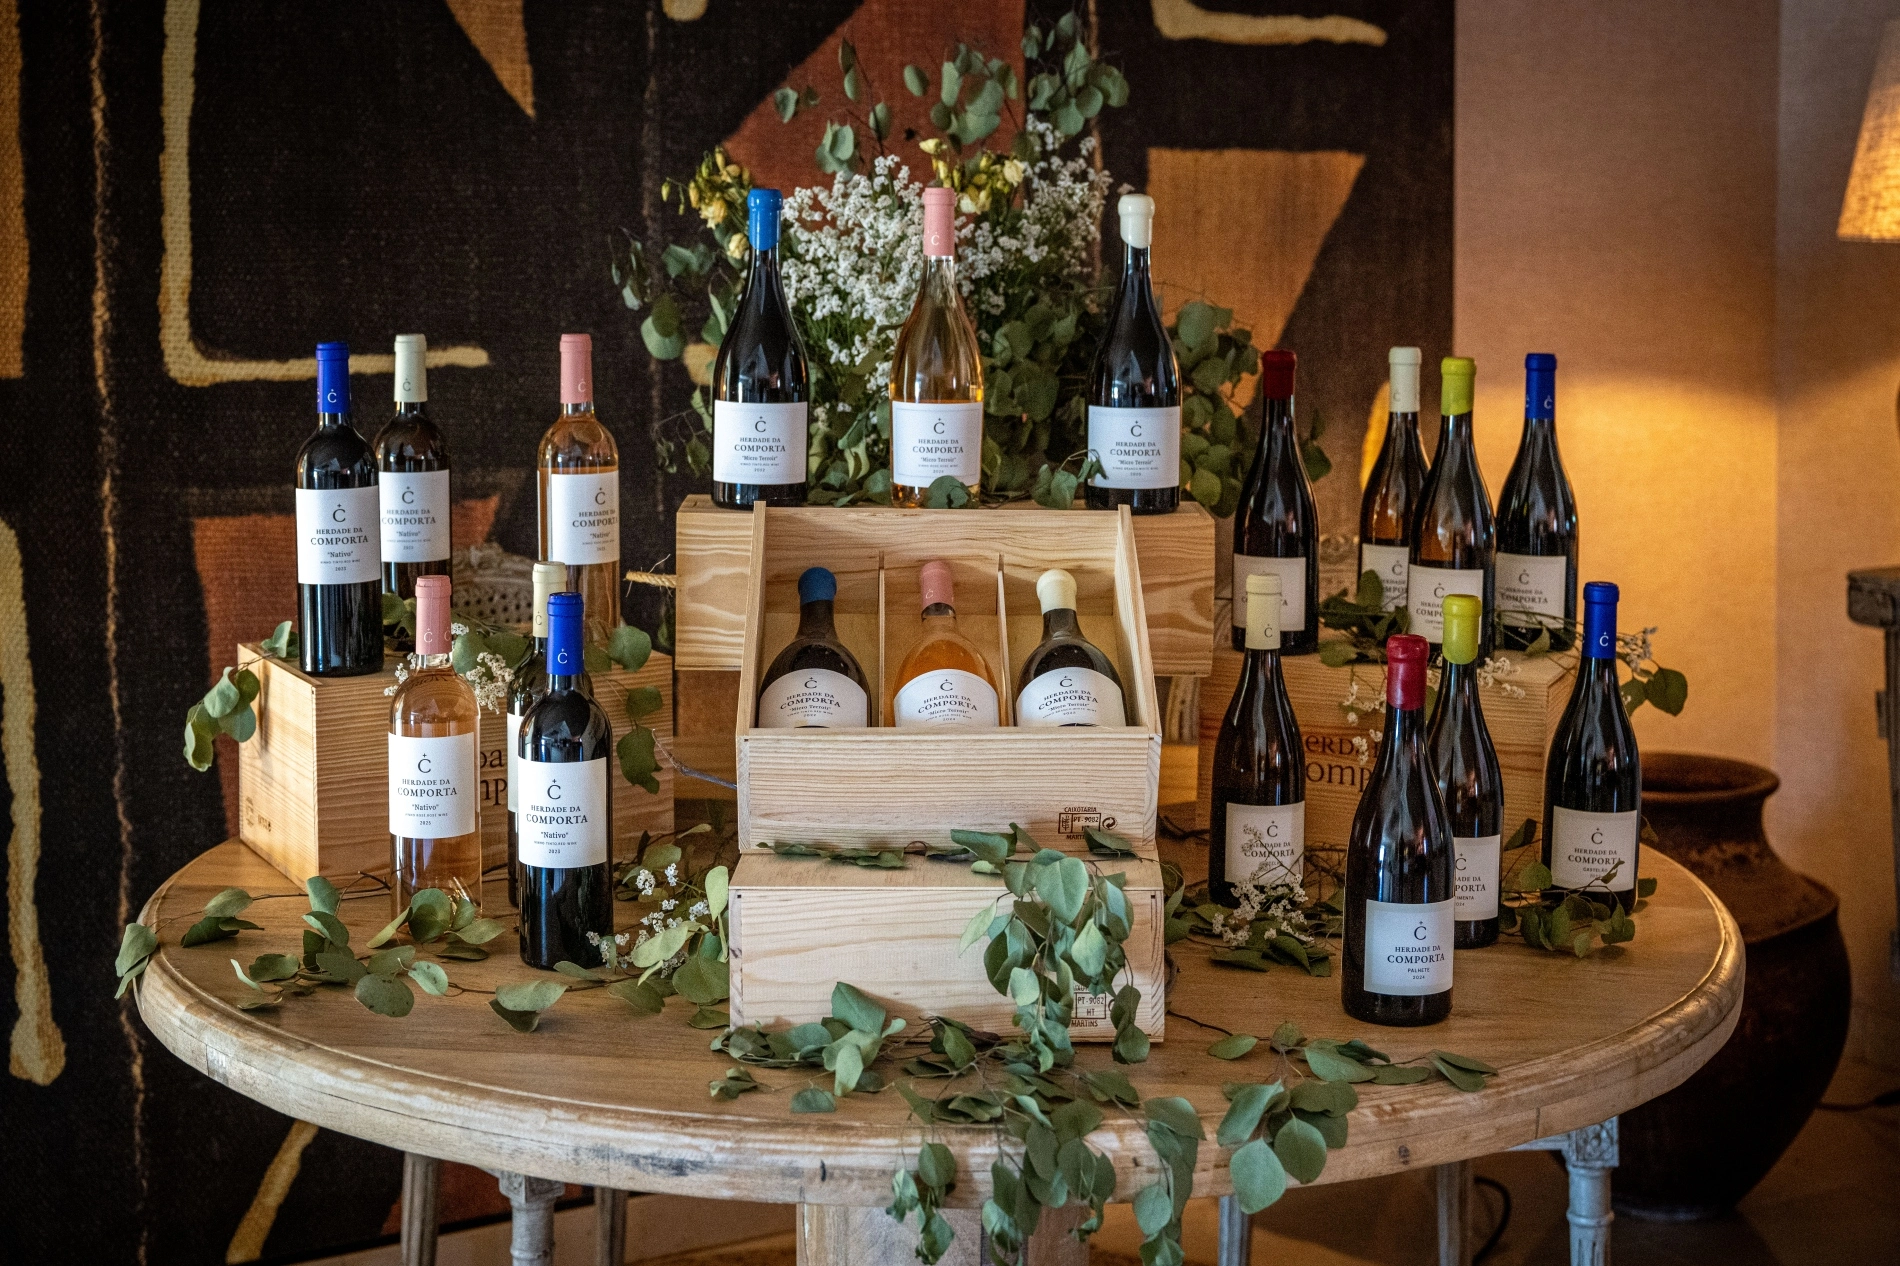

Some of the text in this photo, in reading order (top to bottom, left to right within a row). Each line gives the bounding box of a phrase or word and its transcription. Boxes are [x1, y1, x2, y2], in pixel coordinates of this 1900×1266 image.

[734, 444, 786, 452] COMPORTA
[1110, 449, 1161, 457] COMPORTA
[381, 516, 436, 525] COMPORTA
[316, 527, 352, 535] HERDADE
[310, 535, 369, 545] COMPORTA
[786, 692, 823, 700] HERDADE
[923, 694, 959, 704] HERDADE
[1044, 690, 1079, 701] HERDADE
[780, 697, 841, 710] COMPORTA
[918, 700, 978, 714] COMPORTA
[1038, 695, 1099, 710] COMPORTA
[398, 787, 458, 797] COMPORTA
[531, 805, 567, 813] HERDADE
[526, 813, 588, 825] COMPORTA
[1455, 884, 1486, 892] PORTA
[1387, 953, 1445, 964] COMPORTA
[1086, 1008, 1095, 1016] HT
